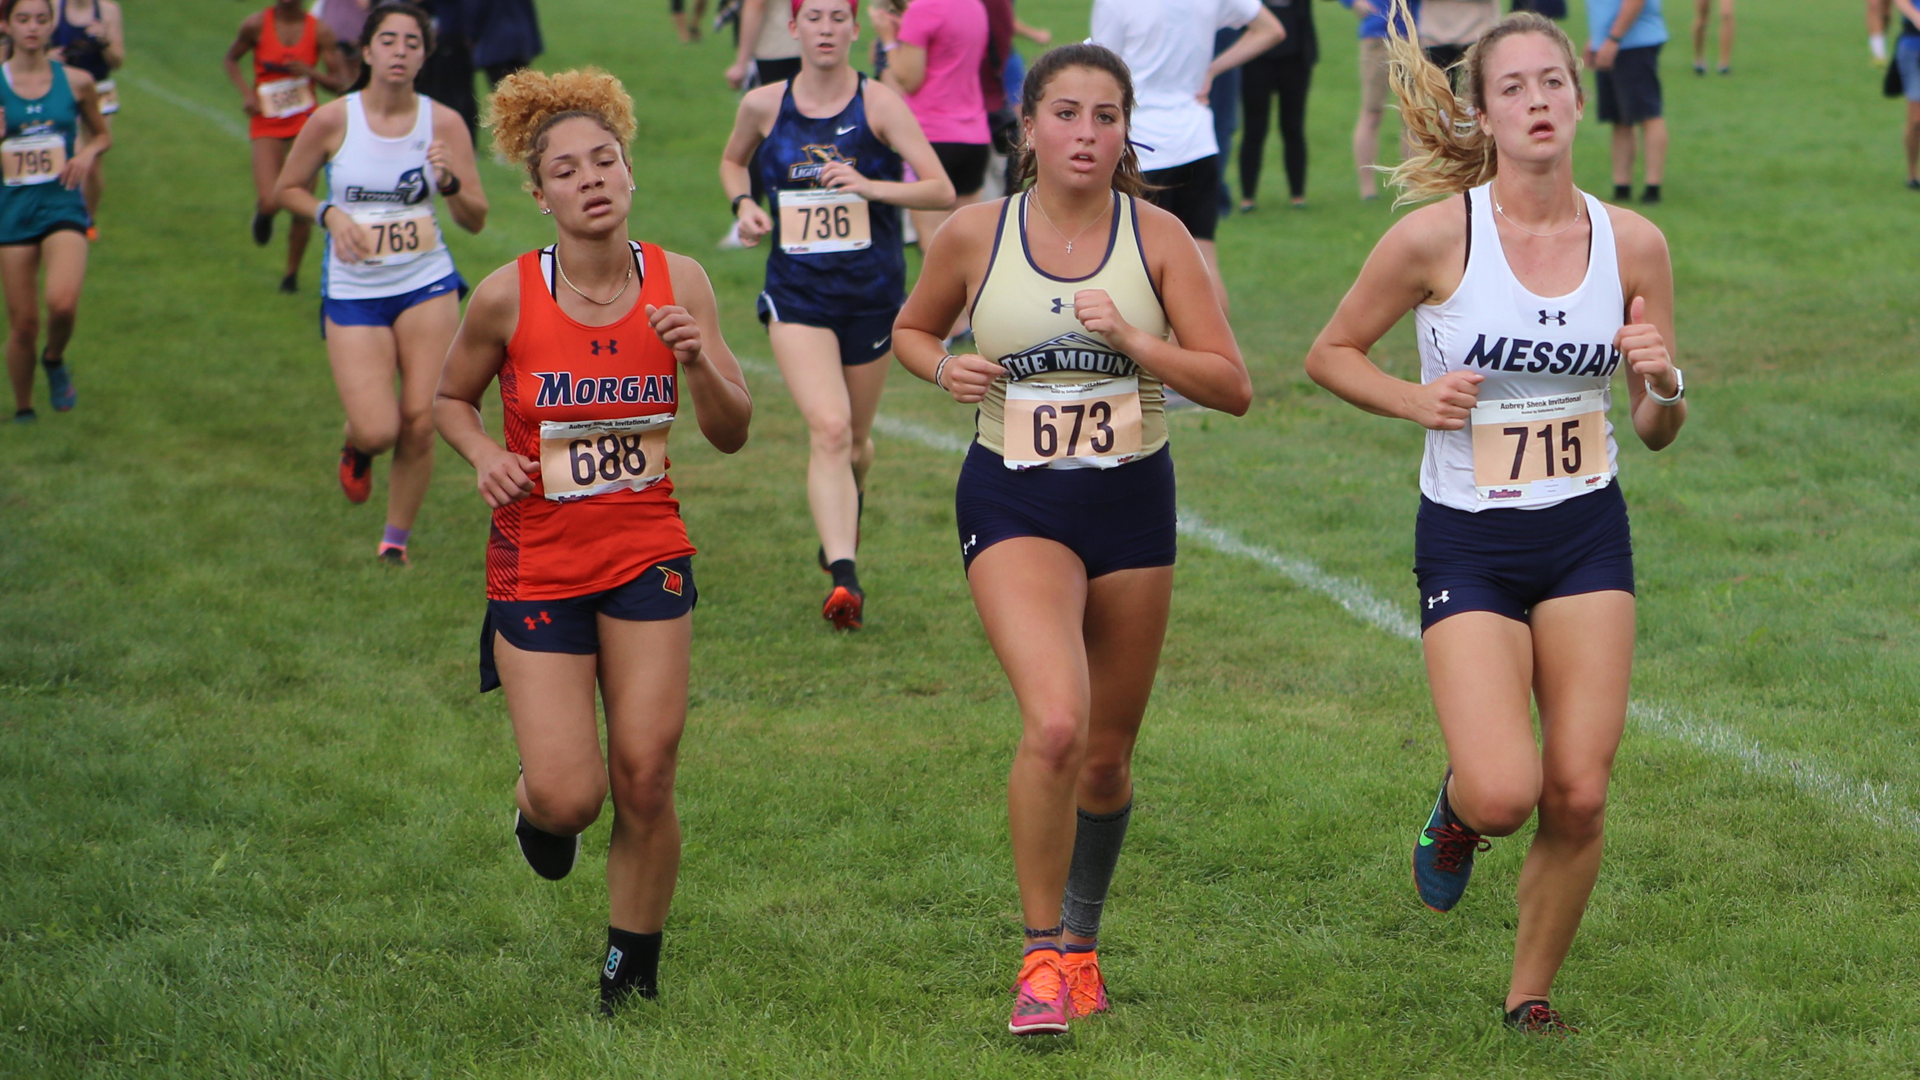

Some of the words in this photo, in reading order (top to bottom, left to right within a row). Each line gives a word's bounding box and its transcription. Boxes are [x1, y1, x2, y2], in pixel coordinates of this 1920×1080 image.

[13, 150, 52, 175] 796
[371, 221, 419, 255] 763
[797, 205, 851, 240] 736
[1001, 352, 1048, 381] THE
[1463, 333, 1622, 377] MESSIAH
[531, 372, 676, 407] MORGAN
[1500, 402, 1525, 410] Aubrey
[1526, 400, 1547, 408] Shenk
[1548, 395, 1582, 405] Invitational
[614, 418, 651, 427] Invitational
[1033, 401, 1115, 458] 673
[568, 433, 647, 486] 688
[1503, 419, 1582, 481] 715
